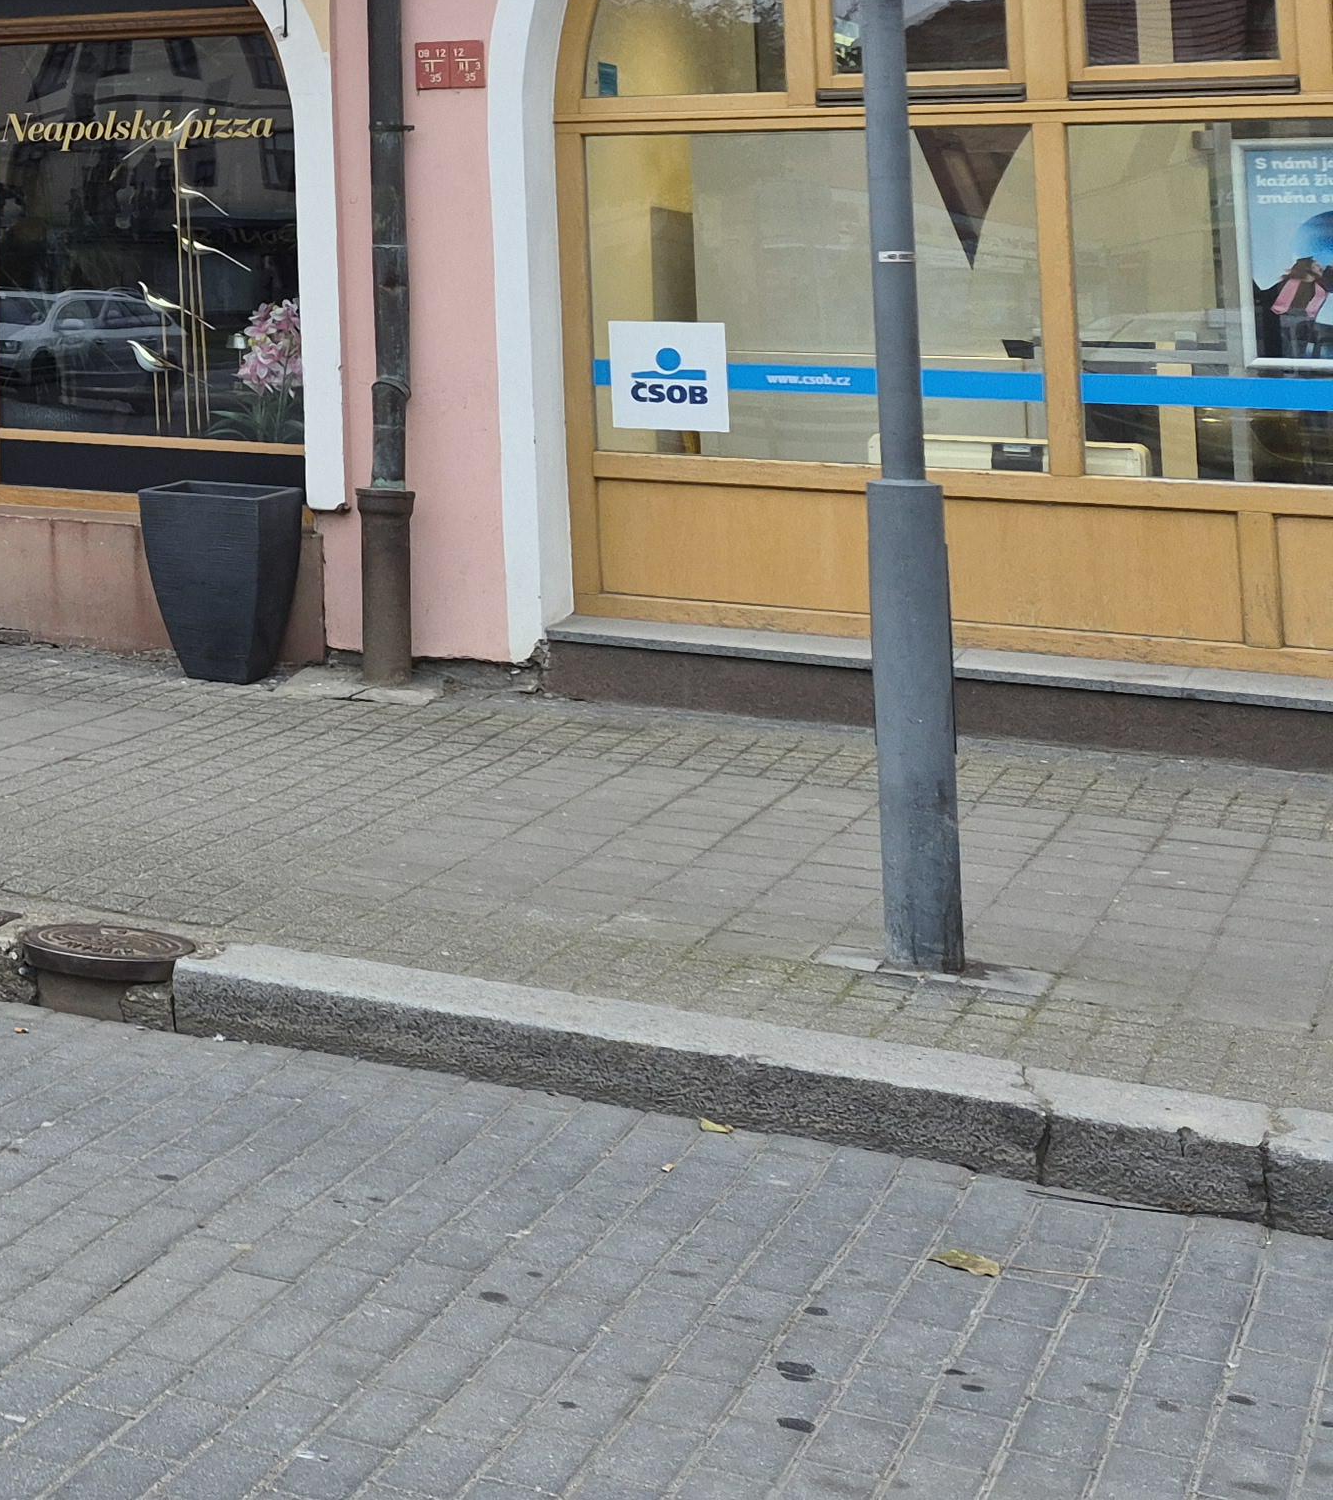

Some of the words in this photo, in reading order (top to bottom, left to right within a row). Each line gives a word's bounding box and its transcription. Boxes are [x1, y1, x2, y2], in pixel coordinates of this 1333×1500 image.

[0, 109, 173, 151] Neapolská
[177, 108, 274, 150] pizza
[1255, 157, 1267, 170] S
[1271, 156, 1318, 170] námi
[1256, 174, 1310, 187] každá
[1256, 191, 1318, 204] změna
[766, 373, 851, 386] www.csob.cz
[631, 380, 708, 405] ČSOB
